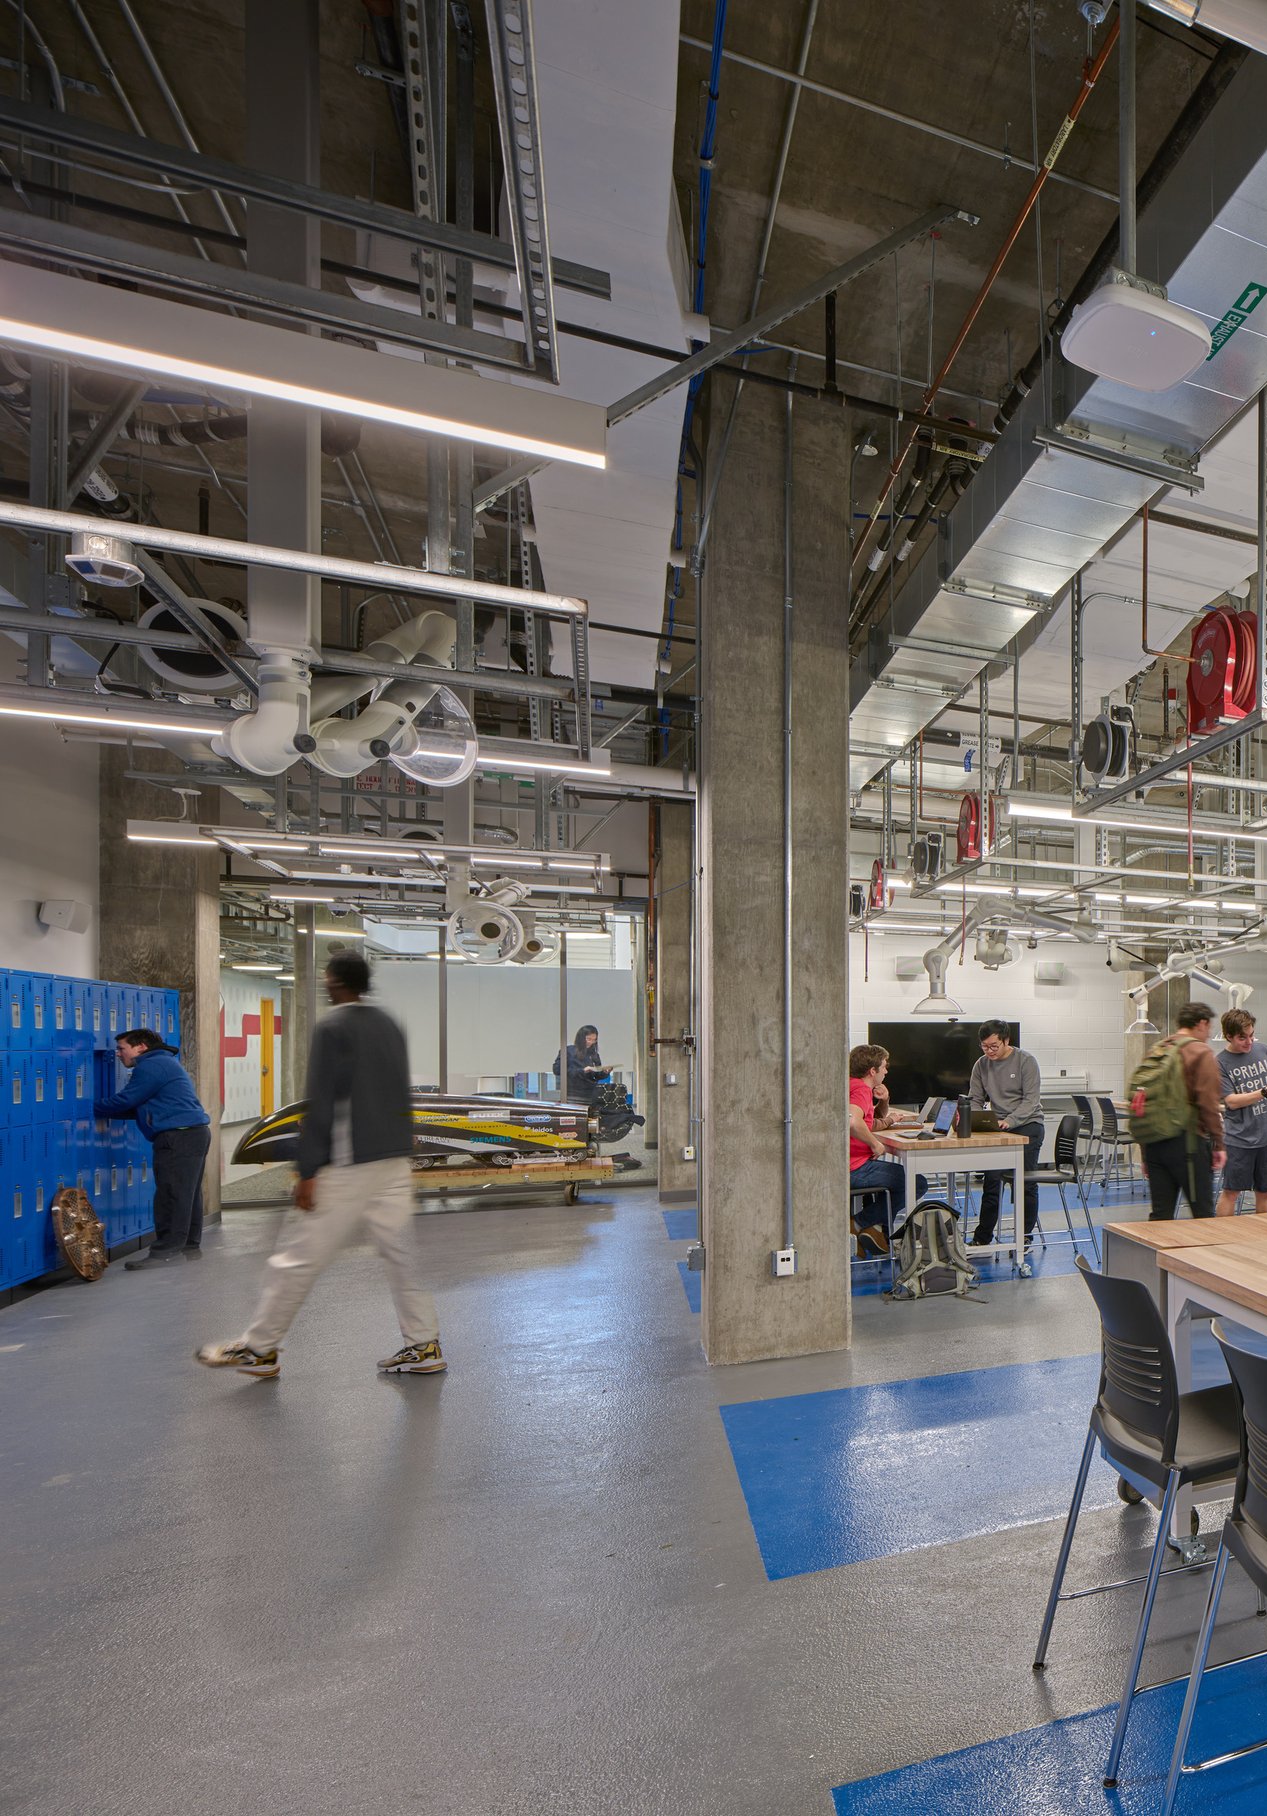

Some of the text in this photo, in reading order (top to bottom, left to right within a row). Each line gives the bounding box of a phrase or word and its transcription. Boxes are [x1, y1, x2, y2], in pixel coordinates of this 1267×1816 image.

[1212, 314, 1242, 347] EXHAUST
[962, 739, 979, 747] GREASE
[1252, 1104, 1267, 1116] ME
[470, 1136, 512, 1144] SIEMENS
